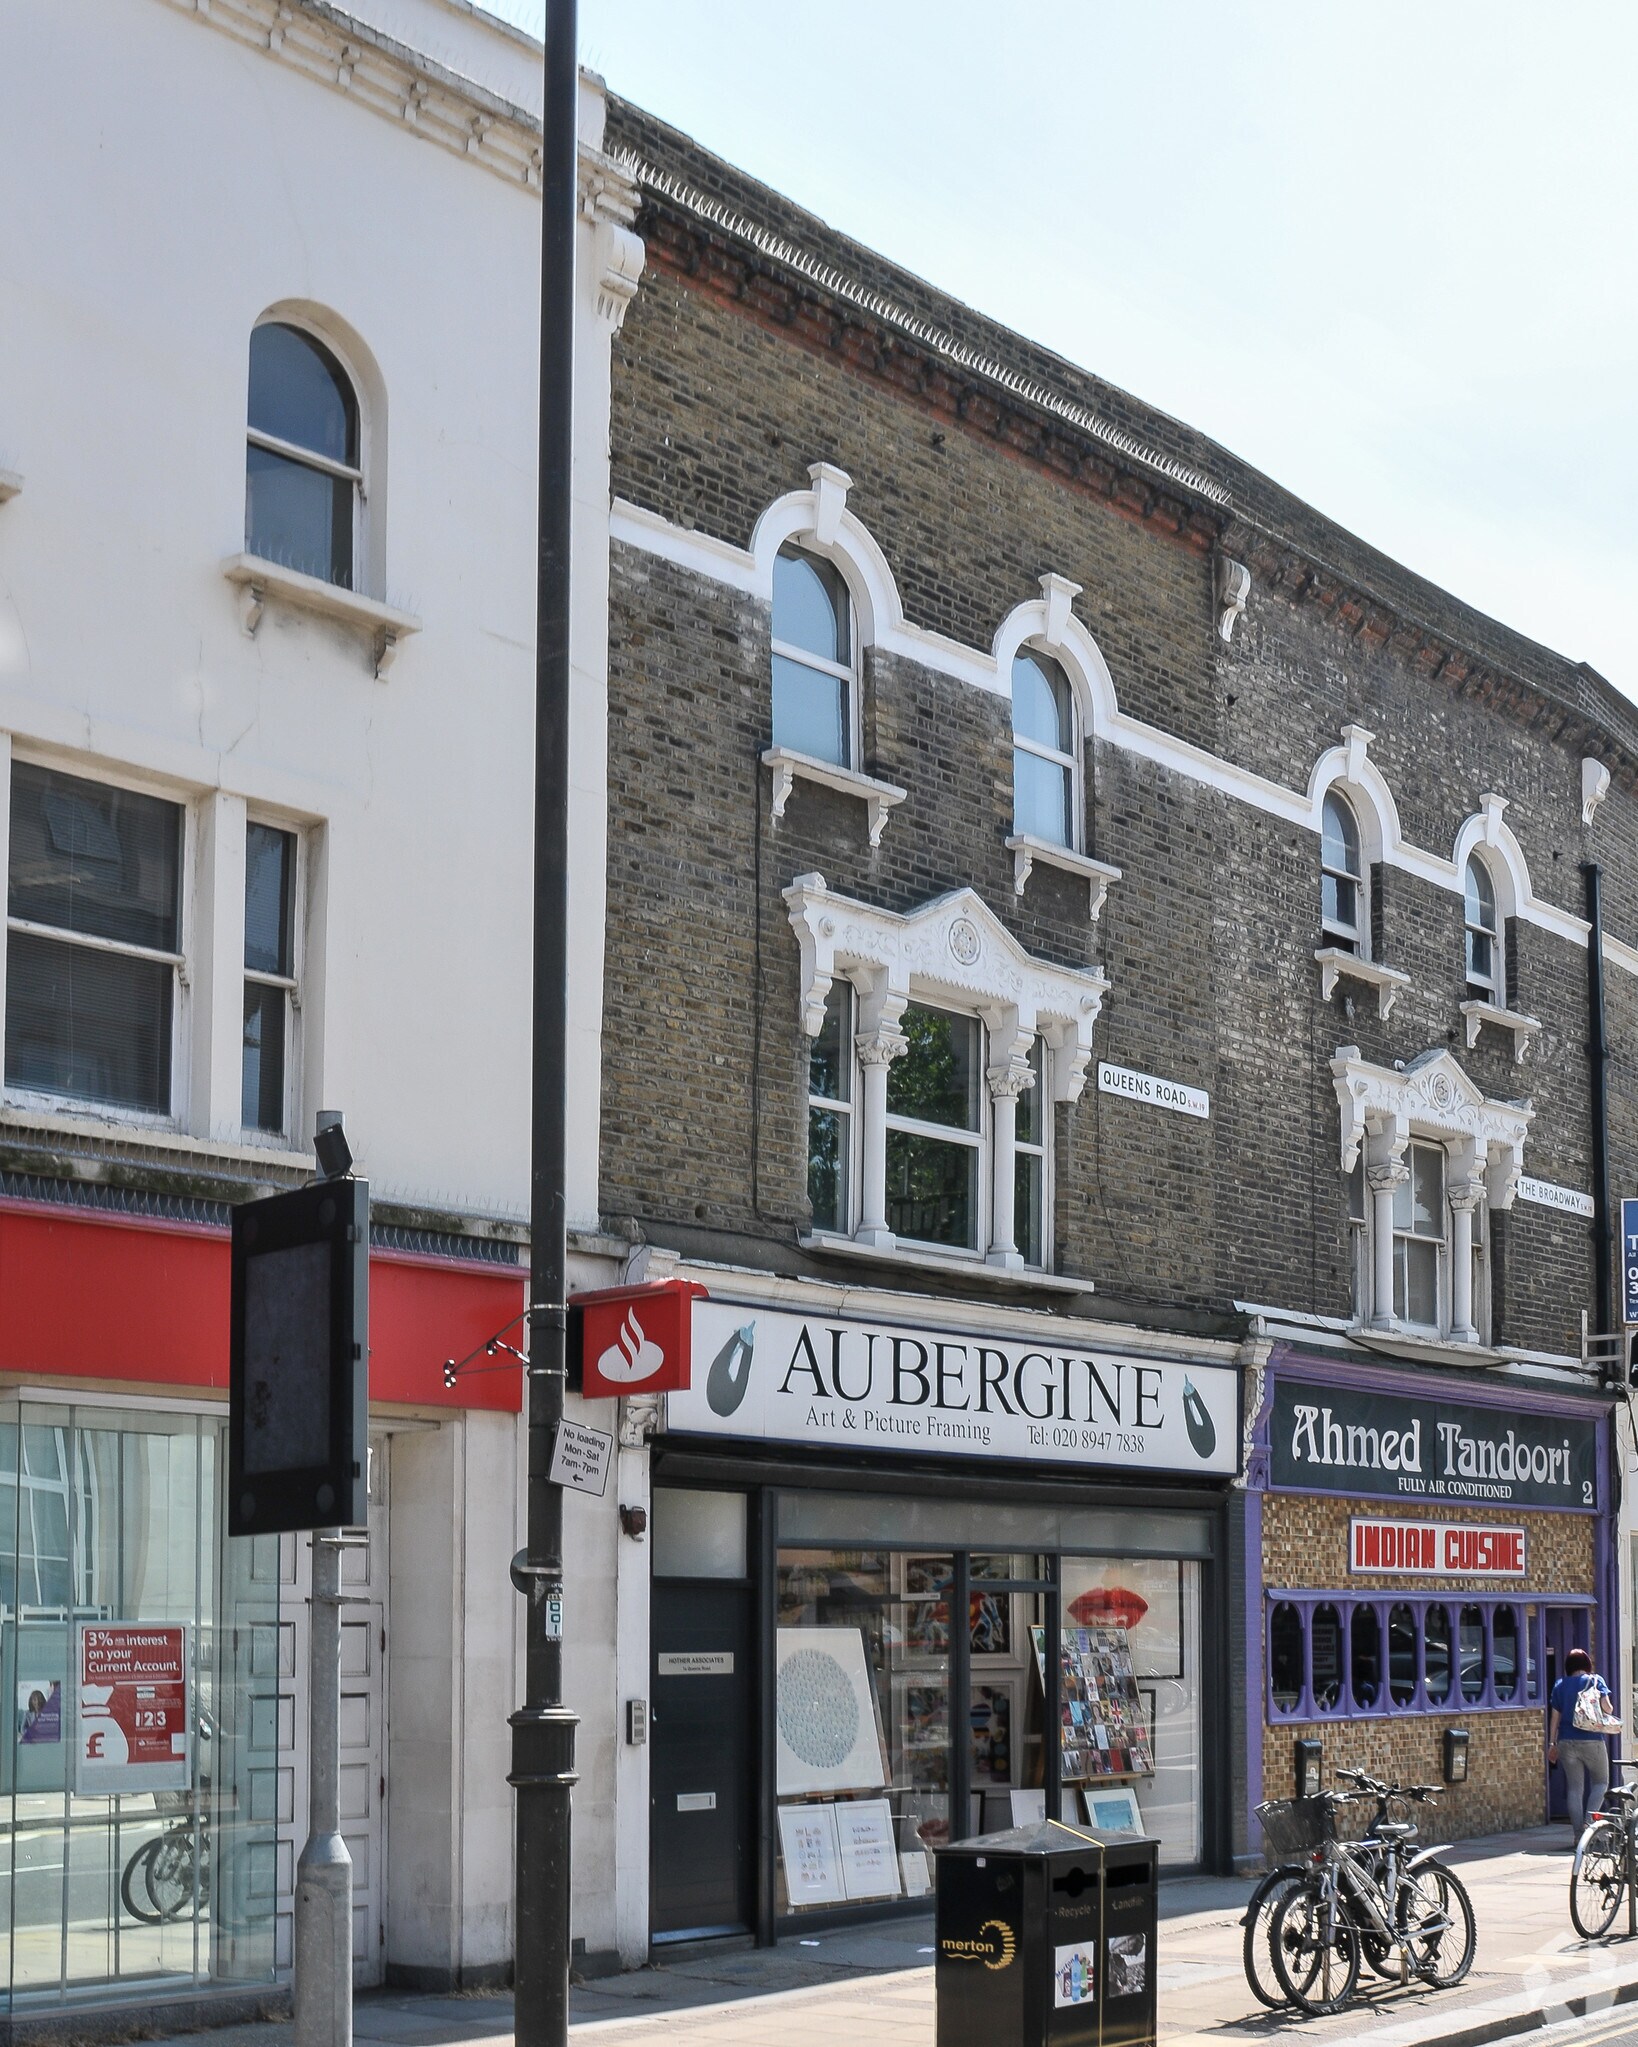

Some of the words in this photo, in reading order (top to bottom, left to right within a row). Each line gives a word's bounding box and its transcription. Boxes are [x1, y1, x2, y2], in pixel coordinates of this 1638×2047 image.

[1103, 1070, 1151, 1096] QUEENS
[1156, 1084, 1187, 1105] ROAD
[1521, 1181, 1536, 1197] THE
[1539, 1186, 1581, 1208] BROADWAY
[776, 1324, 1166, 1430] AUBERGINE
[805, 1406, 836, 1428] Art
[842, 1409, 857, 1430] &
[864, 1411, 921, 1436] Picture
[926, 1416, 991, 1446] Framing
[563, 1427, 575, 1439] No
[577, 1432, 606, 1452] loading
[1027, 1425, 1049, 1446] Tel:
[1052, 1428, 1077, 1448] 020
[1081, 1431, 1112, 1451] 8947
[1116, 1434, 1145, 1454] 7838
[1291, 1404, 1423, 1473] Ahmed
[1436, 1422, 1572, 1486] Tandoori
[1398, 1477, 1426, 1493] FULLY
[1428, 1481, 1446, 1494] AIR
[1447, 1481, 1512, 1499] CONDITIONED
[1582, 1480, 1593, 1505] 2
[1355, 1525, 1436, 1569] INDIAN
[1444, 1530, 1524, 1571] CUISINE
[88, 1631, 114, 1647] 3%
[126, 1633, 169, 1647] interest
[88, 1650, 104, 1660] on
[106, 1649, 132, 1662] your
[88, 1661, 132, 1674] Current
[133, 1660, 180, 1673] Account.
[691, 1656, 725, 1664] ASSOCIATES
[1059, 1904, 1092, 1918] Recycle
[942, 1939, 995, 1954] merton
